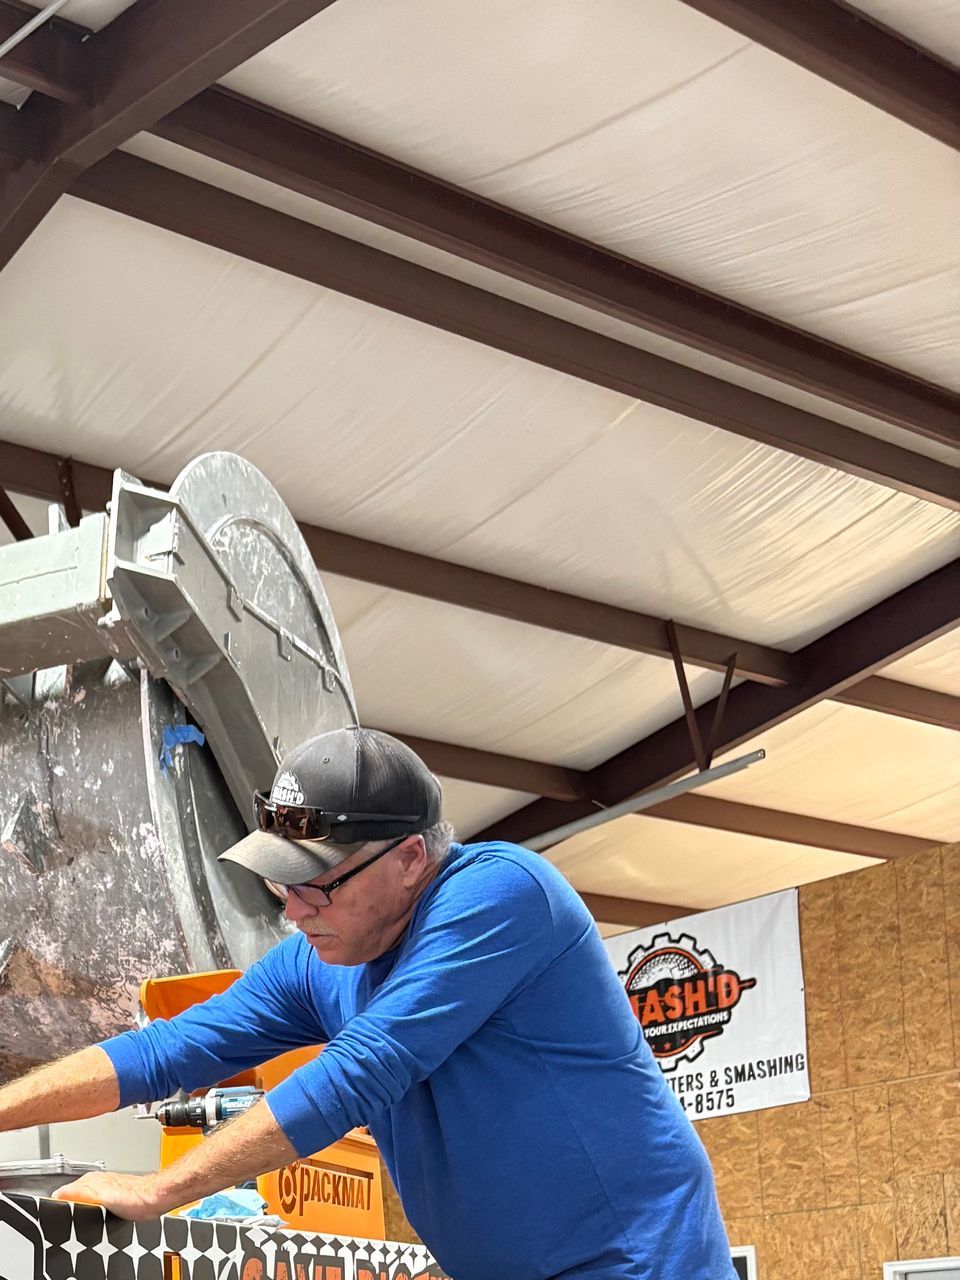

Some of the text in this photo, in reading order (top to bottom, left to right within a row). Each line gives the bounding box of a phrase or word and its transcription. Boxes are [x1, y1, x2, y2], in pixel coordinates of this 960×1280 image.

[630, 973, 740, 1026] ASH'D
[668, 1012, 729, 1034] EXPECTATIONS
[667, 1053, 805, 1093] TERS & SMASHING
